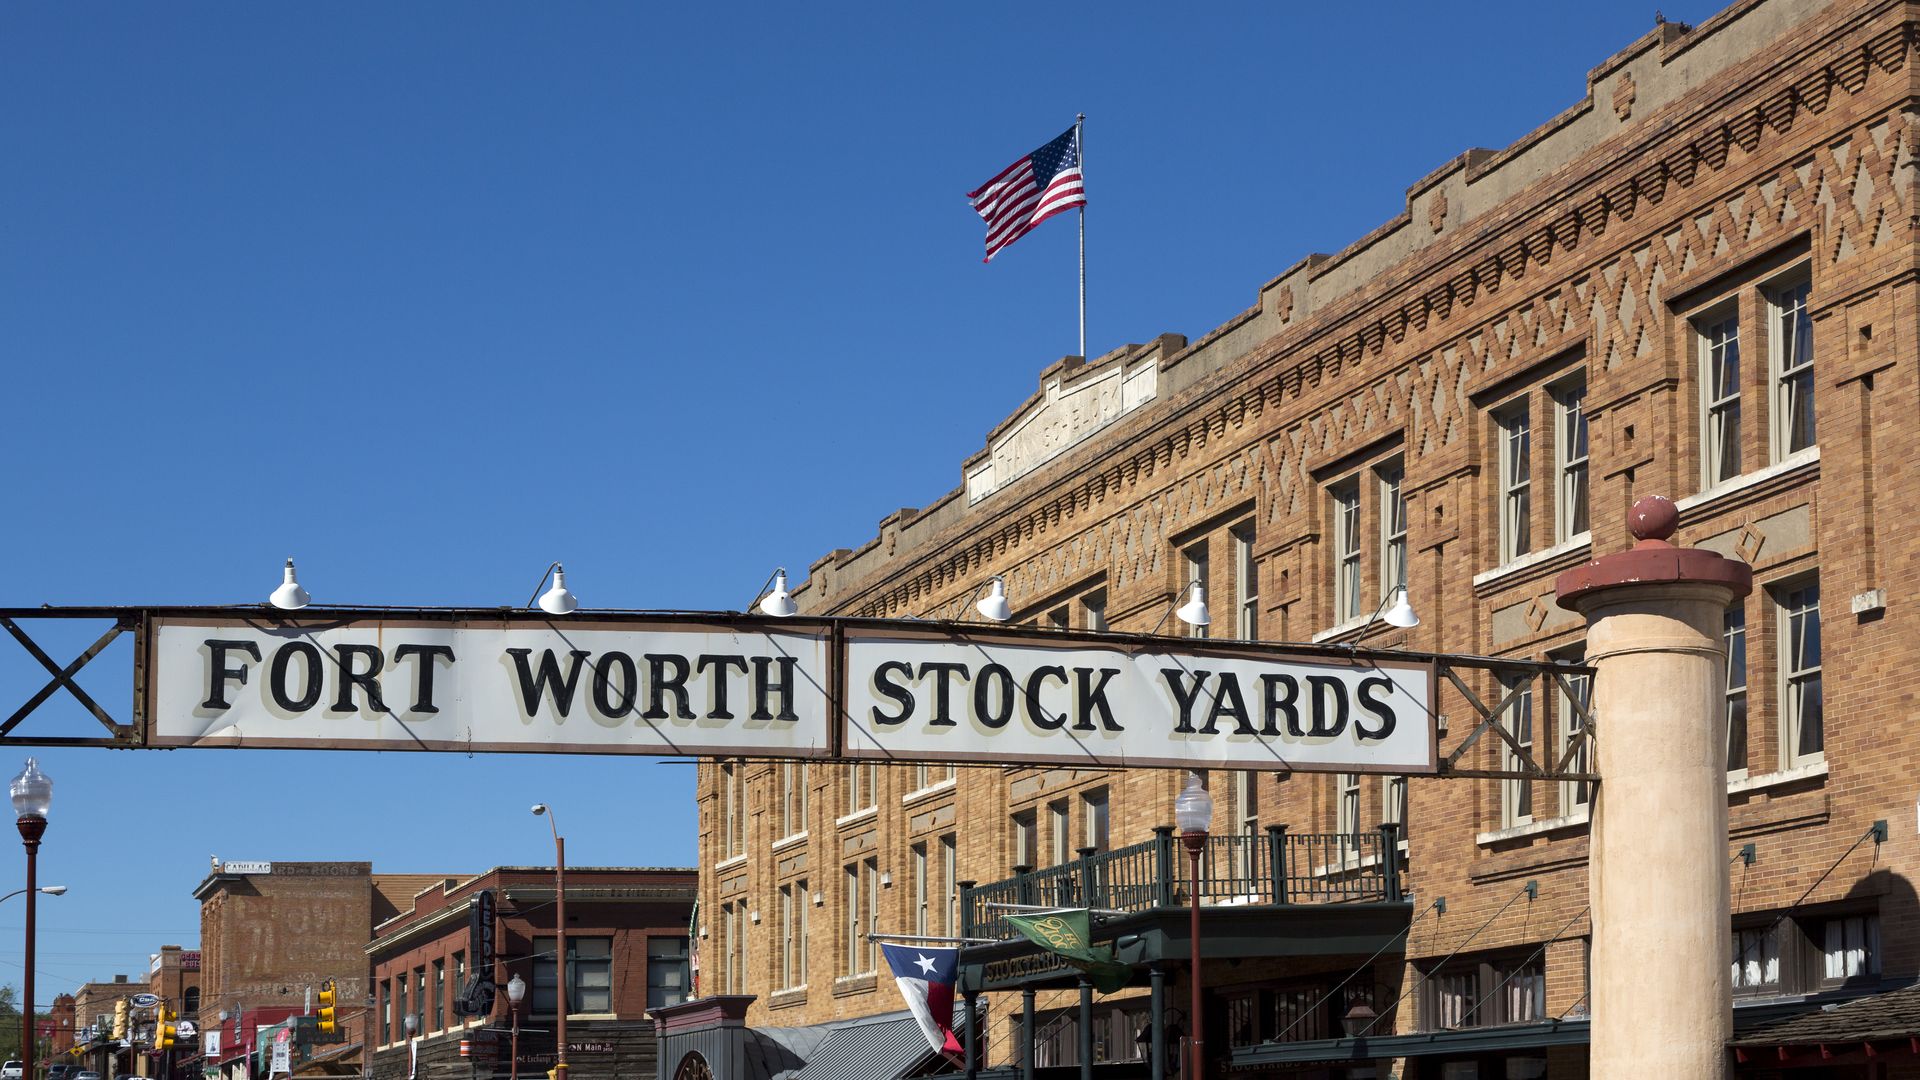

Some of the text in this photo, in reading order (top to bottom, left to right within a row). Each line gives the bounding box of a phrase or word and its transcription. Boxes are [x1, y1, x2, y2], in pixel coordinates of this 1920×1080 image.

[201, 639, 1397, 740] FORT WORTH STOCK YARDS
[225, 863, 271, 873] CADILLAC
[585, 1043, 602, 1051] Main
